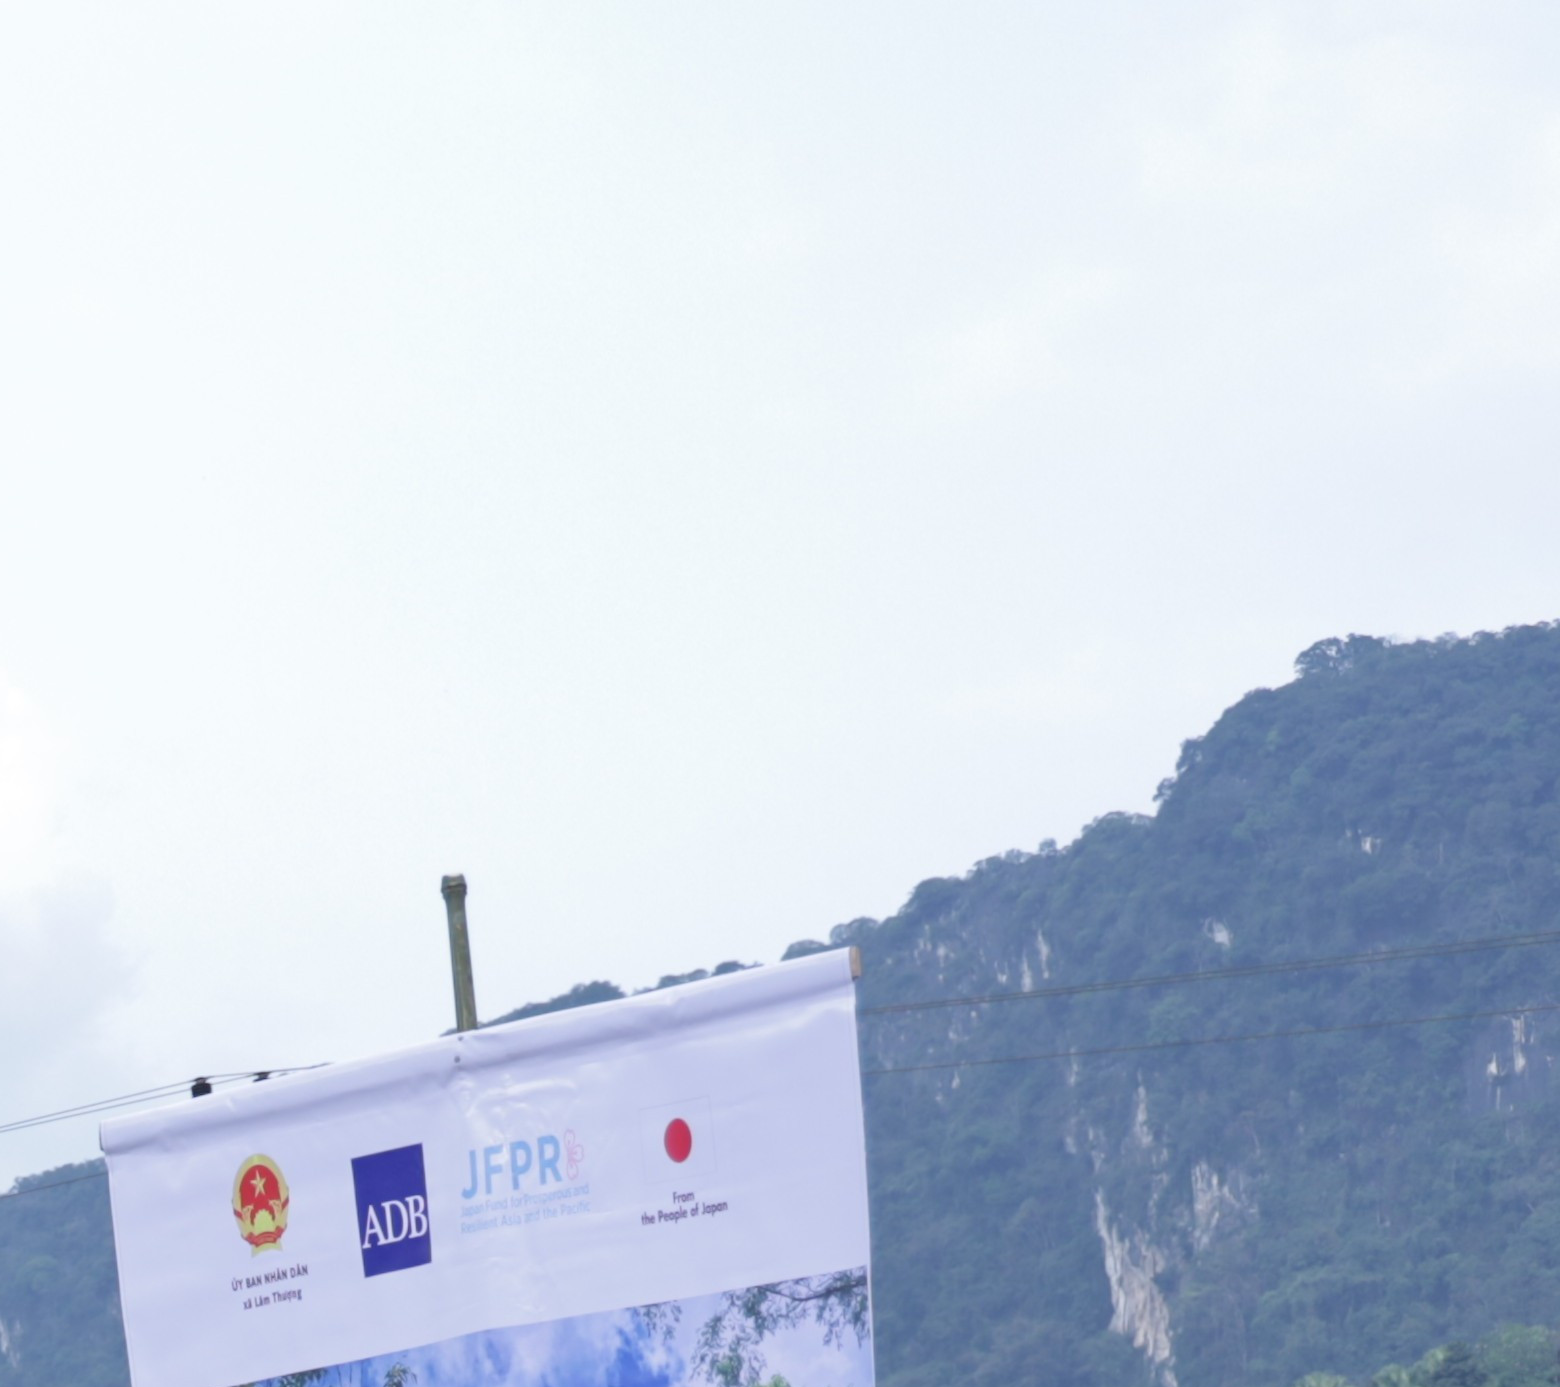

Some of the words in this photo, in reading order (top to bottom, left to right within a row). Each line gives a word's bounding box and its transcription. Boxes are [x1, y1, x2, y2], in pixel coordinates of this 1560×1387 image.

[461, 1134, 563, 1200] JFPR
[672, 1191, 695, 1204] From
[362, 1194, 428, 1249] ADB
[641, 1211, 656, 1225] the
[657, 1205, 688, 1224] People
[690, 1202, 699, 1217] of
[702, 1201, 728, 1217] Japan
[245, 1275, 262, 1288] BAN
[264, 1267, 288, 1284] NHÂN
[290, 1263, 308, 1278] DÂN
[254, 1295, 270, 1308] Lâm
